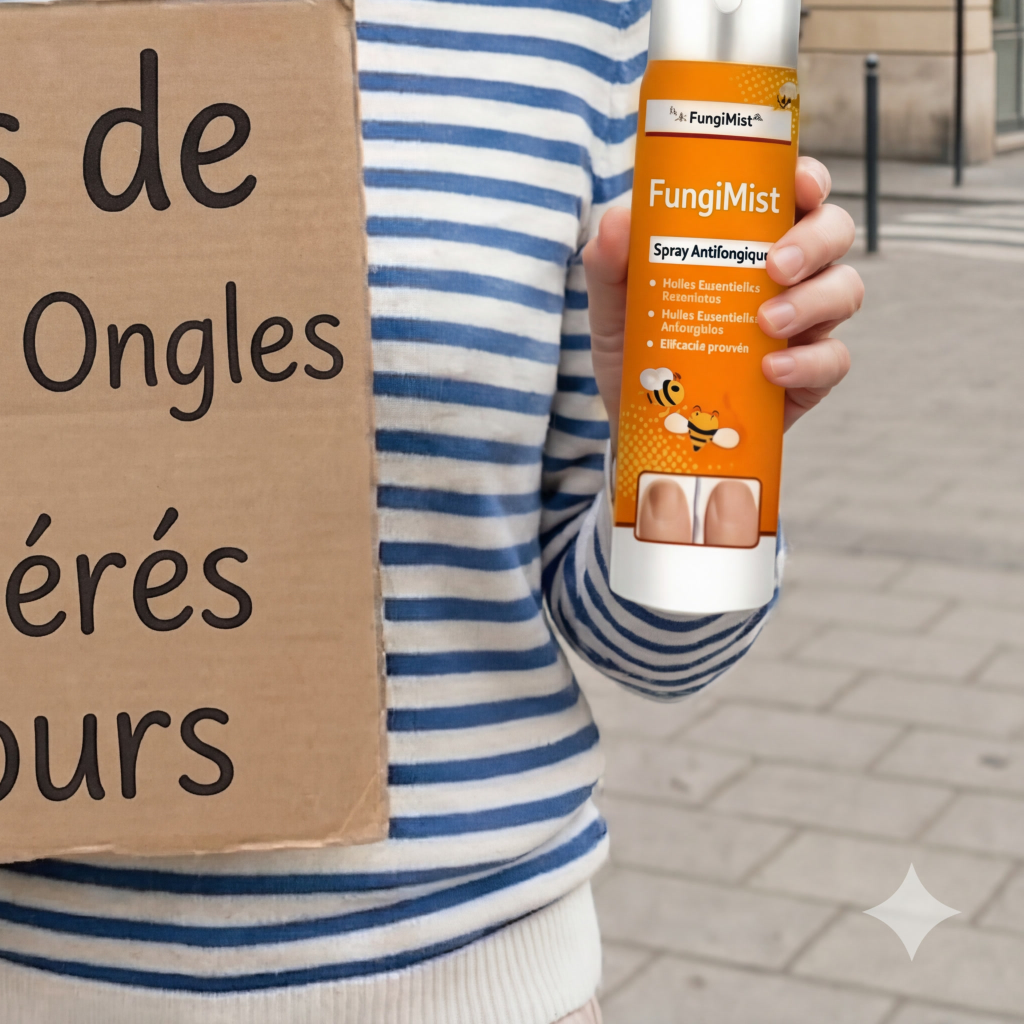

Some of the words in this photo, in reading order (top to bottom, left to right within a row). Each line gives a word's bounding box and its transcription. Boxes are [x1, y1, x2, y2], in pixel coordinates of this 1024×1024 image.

[82, 48, 257, 212] de
[690, 110, 753, 128] FungiMist
[649, 178, 781, 217] FungiMist
[653, 242, 689, 261] Spray
[22, 281, 345, 422] Ongles
